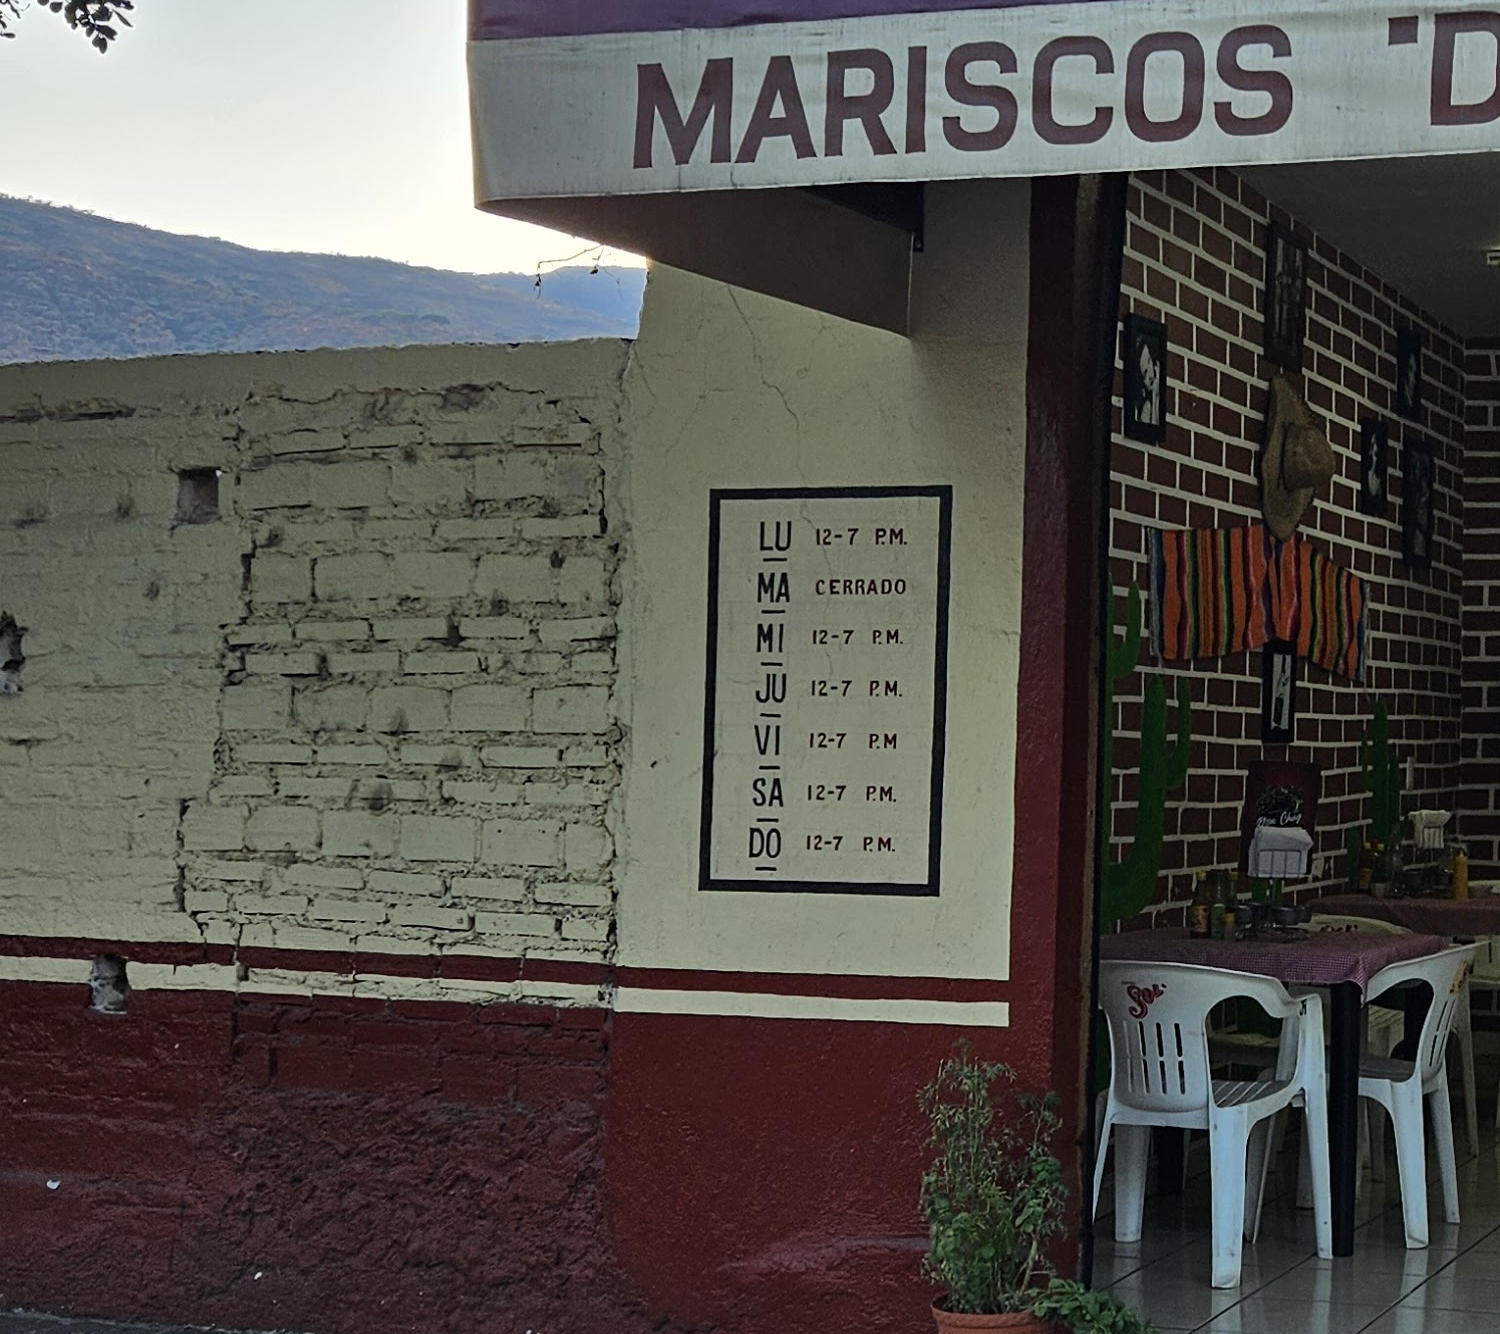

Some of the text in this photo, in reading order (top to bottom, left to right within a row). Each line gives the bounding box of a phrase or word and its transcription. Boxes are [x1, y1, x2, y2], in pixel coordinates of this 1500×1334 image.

[632, 24, 1293, 170] MARISCOS
[760, 521, 907, 551] LU 12-7 P.M.
[758, 573, 906, 603] MA CERRADO
[757, 624, 904, 652] MI 12-7 P.M.
[756, 674, 902, 703] JU 12-7 P.M.
[754, 725, 780, 755] VI
[810, 733, 846, 748] 12-7
[753, 778, 896, 807] SA 12-7 P.M.
[749, 828, 895, 858] DO 12-7 P.M.
